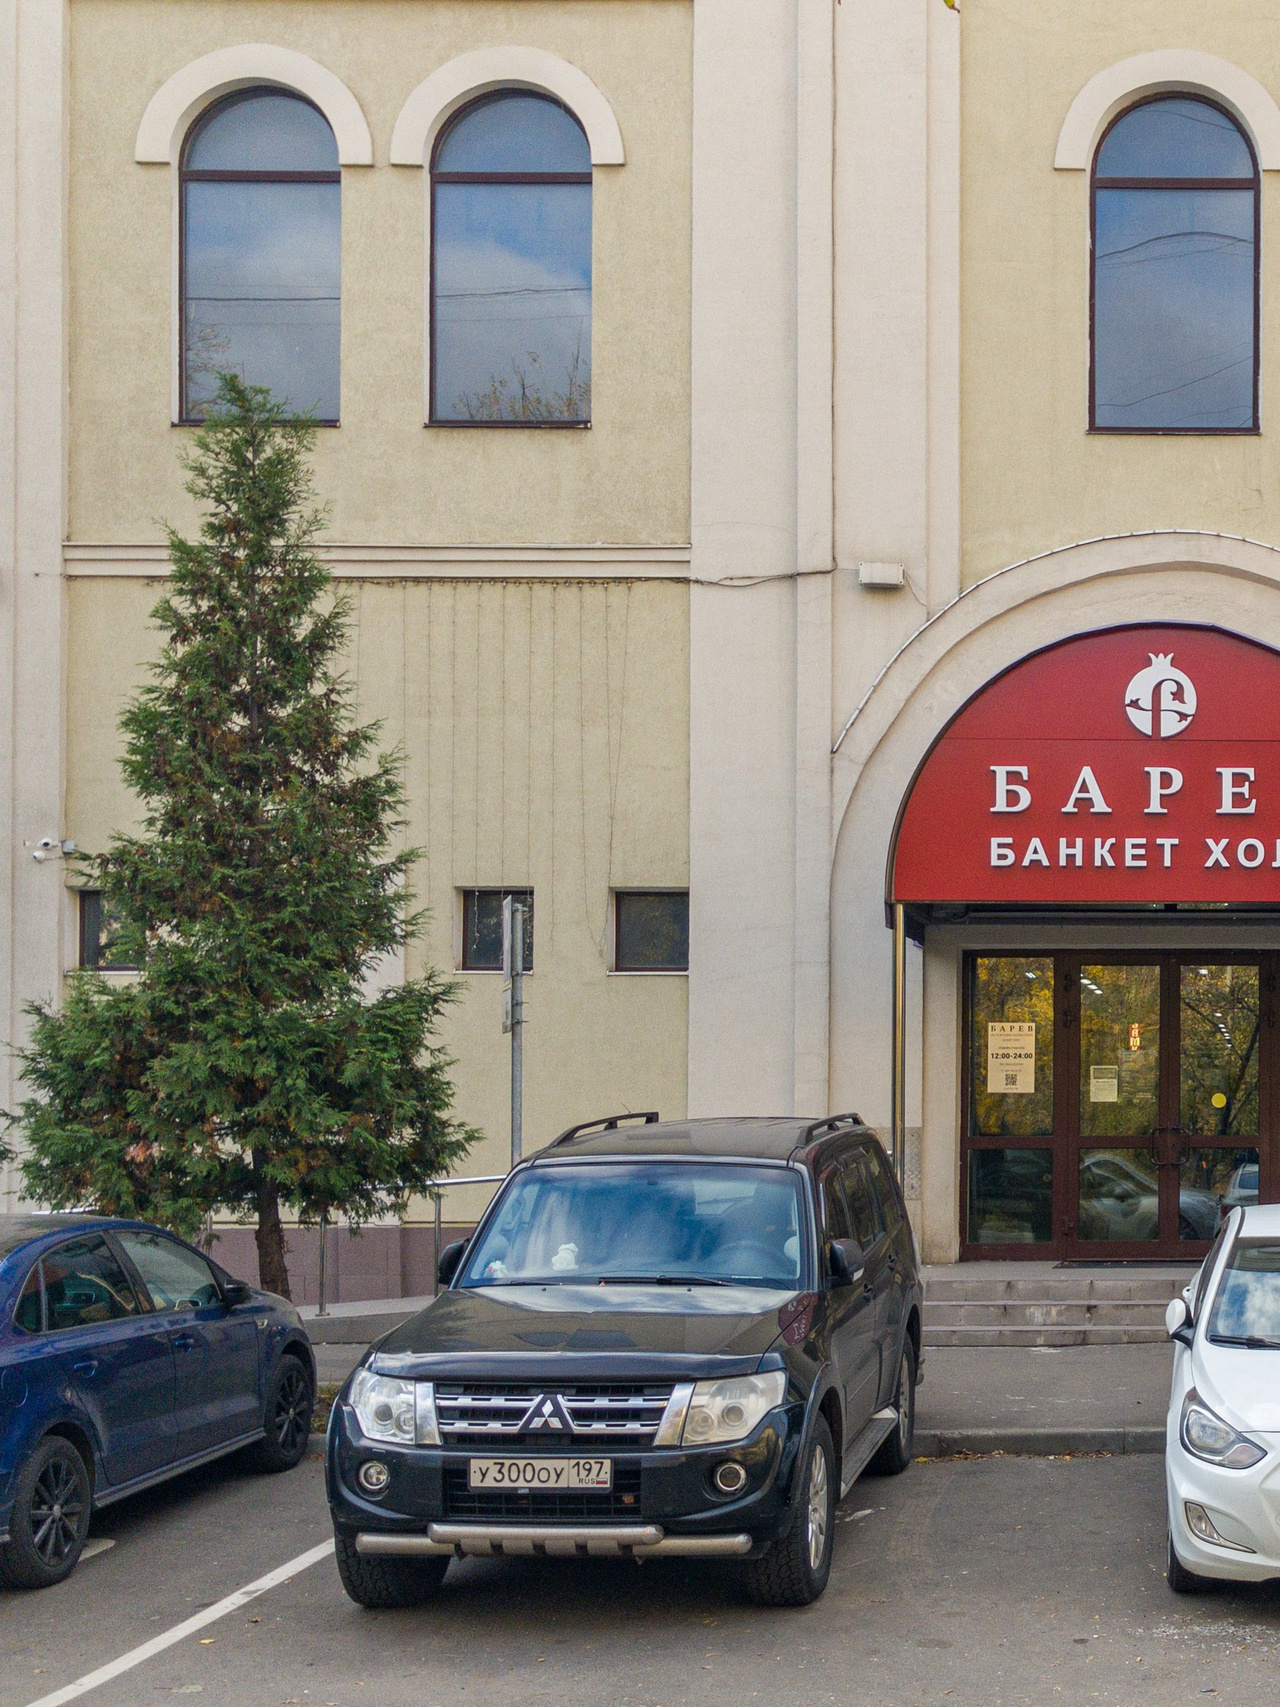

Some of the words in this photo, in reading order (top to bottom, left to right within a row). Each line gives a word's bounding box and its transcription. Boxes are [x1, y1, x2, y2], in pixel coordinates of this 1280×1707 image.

[990, 837, 1180, 868] БАНКЕТ
[478, 1462, 564, 1484] У300ОУ
[572, 1461, 604, 1477] 197
